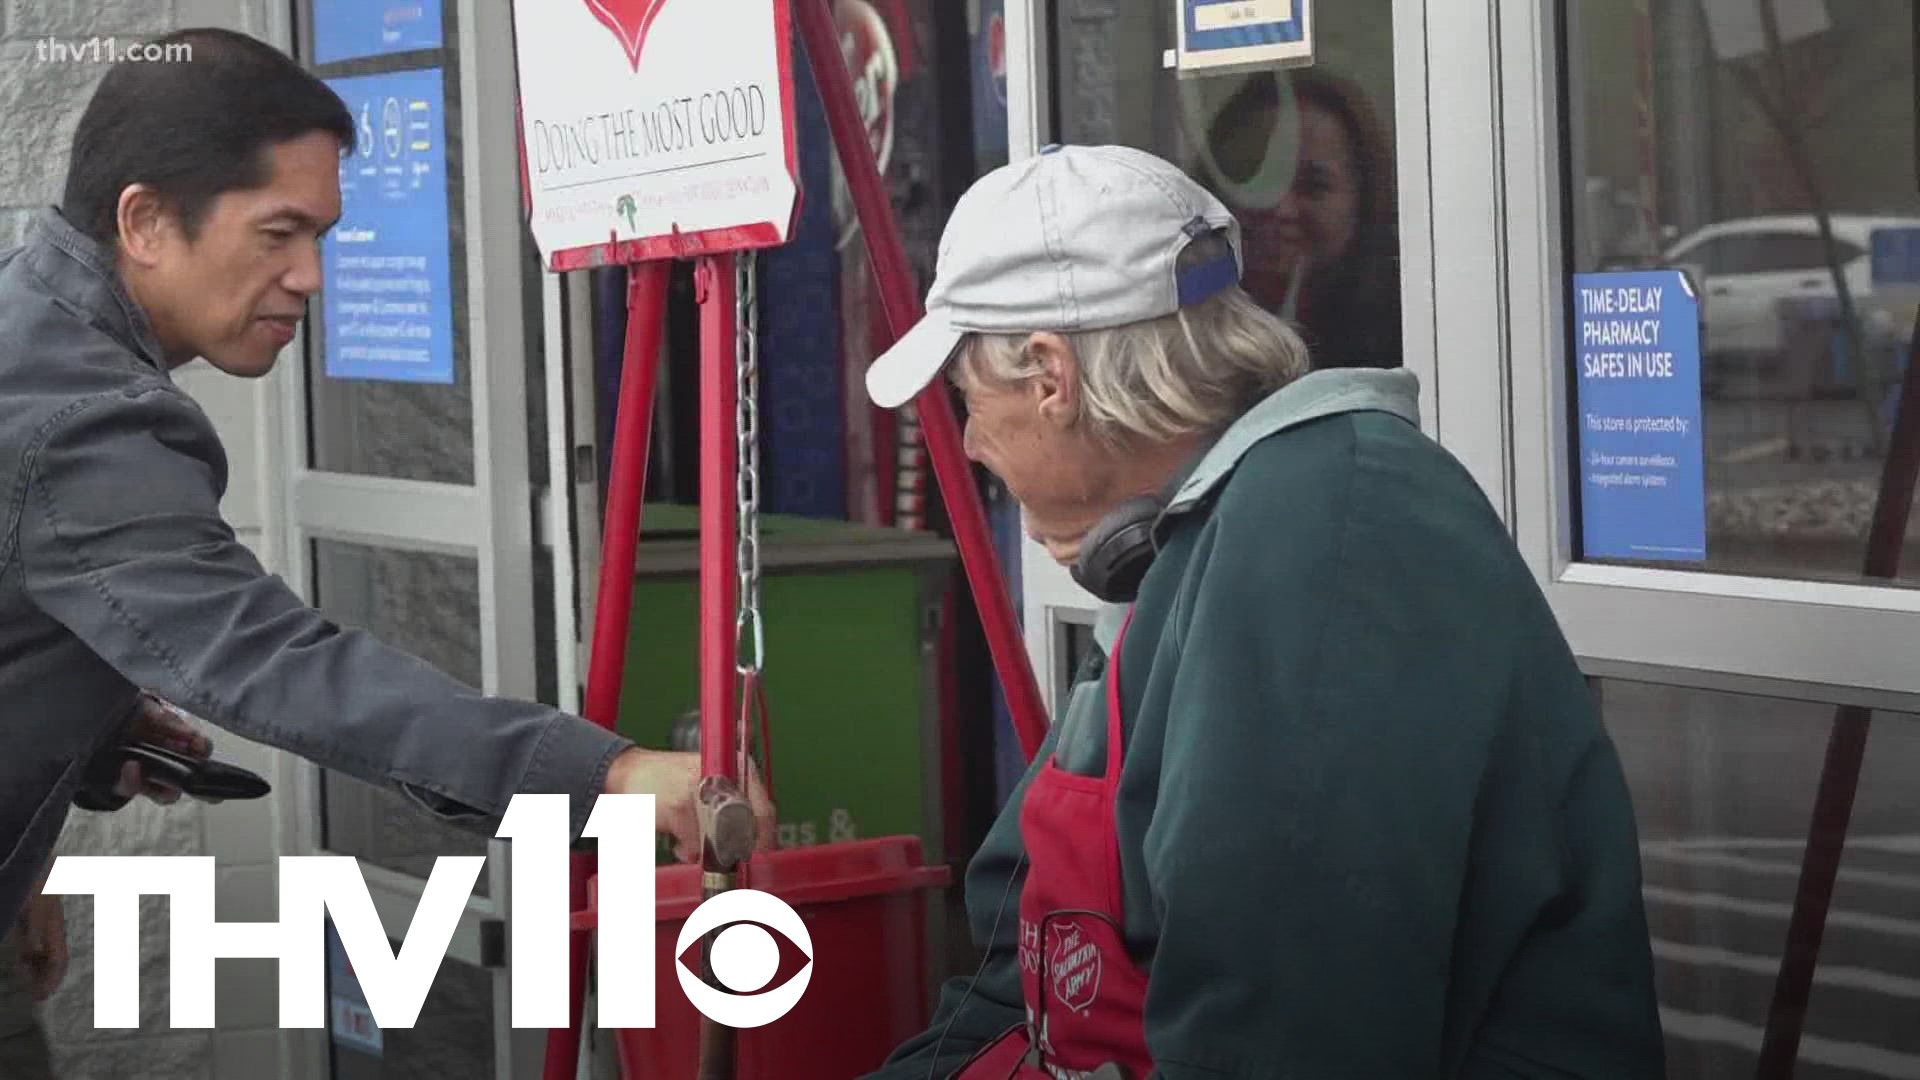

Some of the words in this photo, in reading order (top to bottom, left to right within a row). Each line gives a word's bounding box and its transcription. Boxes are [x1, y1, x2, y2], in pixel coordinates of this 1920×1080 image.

[535, 118, 600, 174] DOING
[600, 109, 640, 161] THE
[641, 97, 695, 155] MOST
[699, 84, 765, 144] GOOD
[1581, 287, 1663, 313] TIME-DELAY
[1583, 320, 1660, 347] PHARMACY
[1584, 354, 1625, 378] SAFES
[1628, 354, 1643, 376] IN
[1646, 353, 1673, 377] USE
[1586, 414, 1601, 431] This
[1603, 416, 1625, 431] store
[1626, 418, 1632, 431] is
[1633, 416, 1675, 434] protected
[1676, 415, 1689, 437] by:
